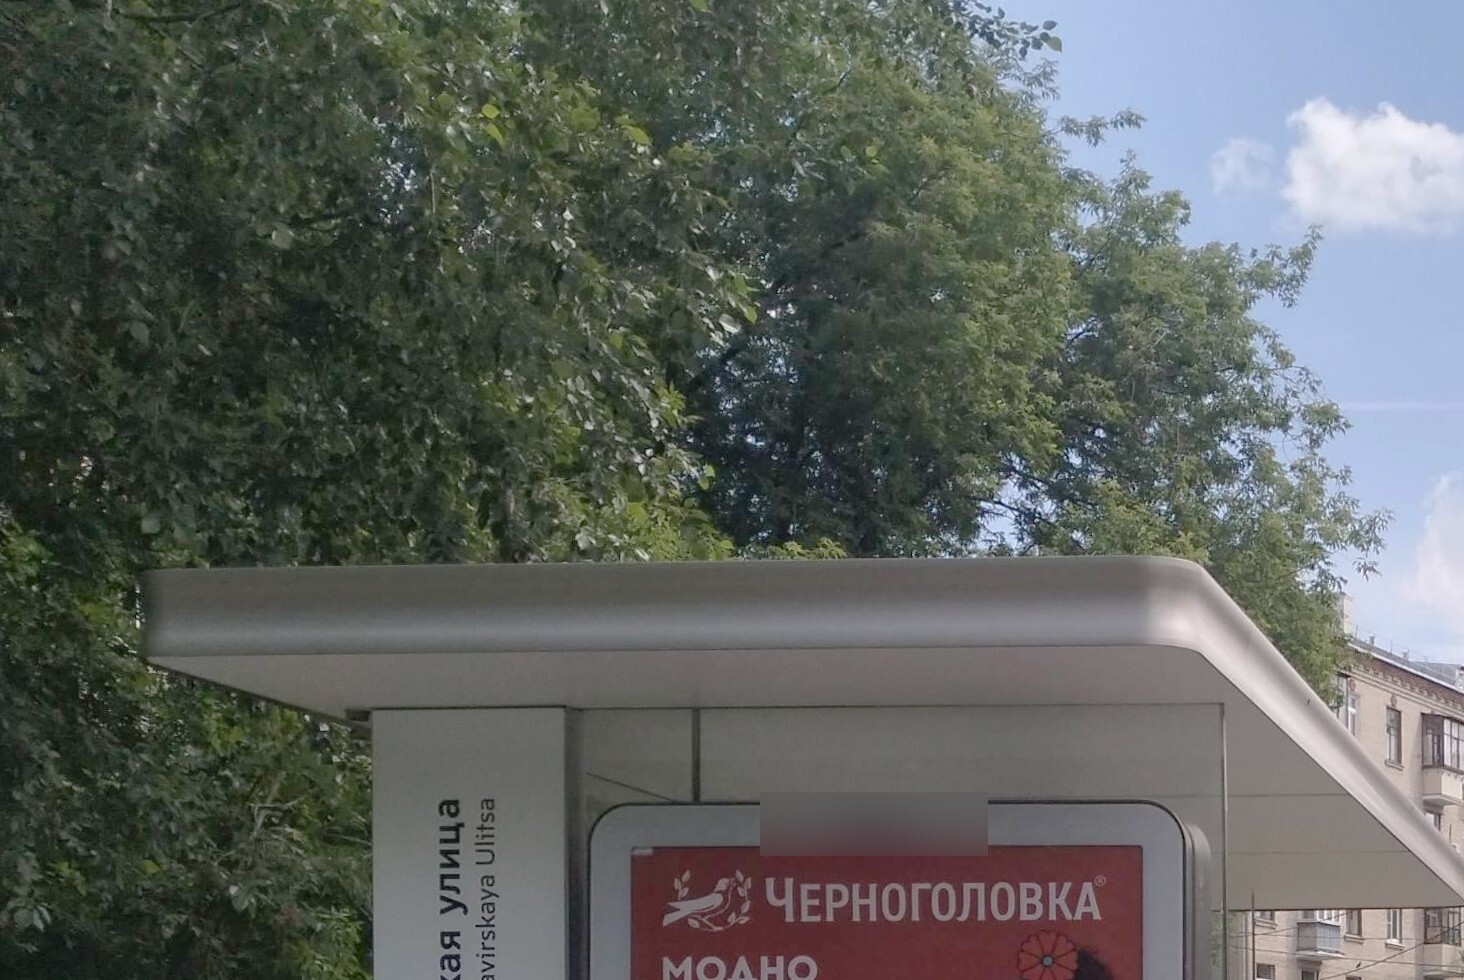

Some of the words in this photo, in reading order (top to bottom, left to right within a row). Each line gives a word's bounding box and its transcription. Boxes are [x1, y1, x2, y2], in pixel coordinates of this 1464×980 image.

[438, 798, 468, 915] улица
[474, 797, 496, 865] Ulitsa
[765, 876, 1102, 923] ЧЕРНОГОЛОВКА
